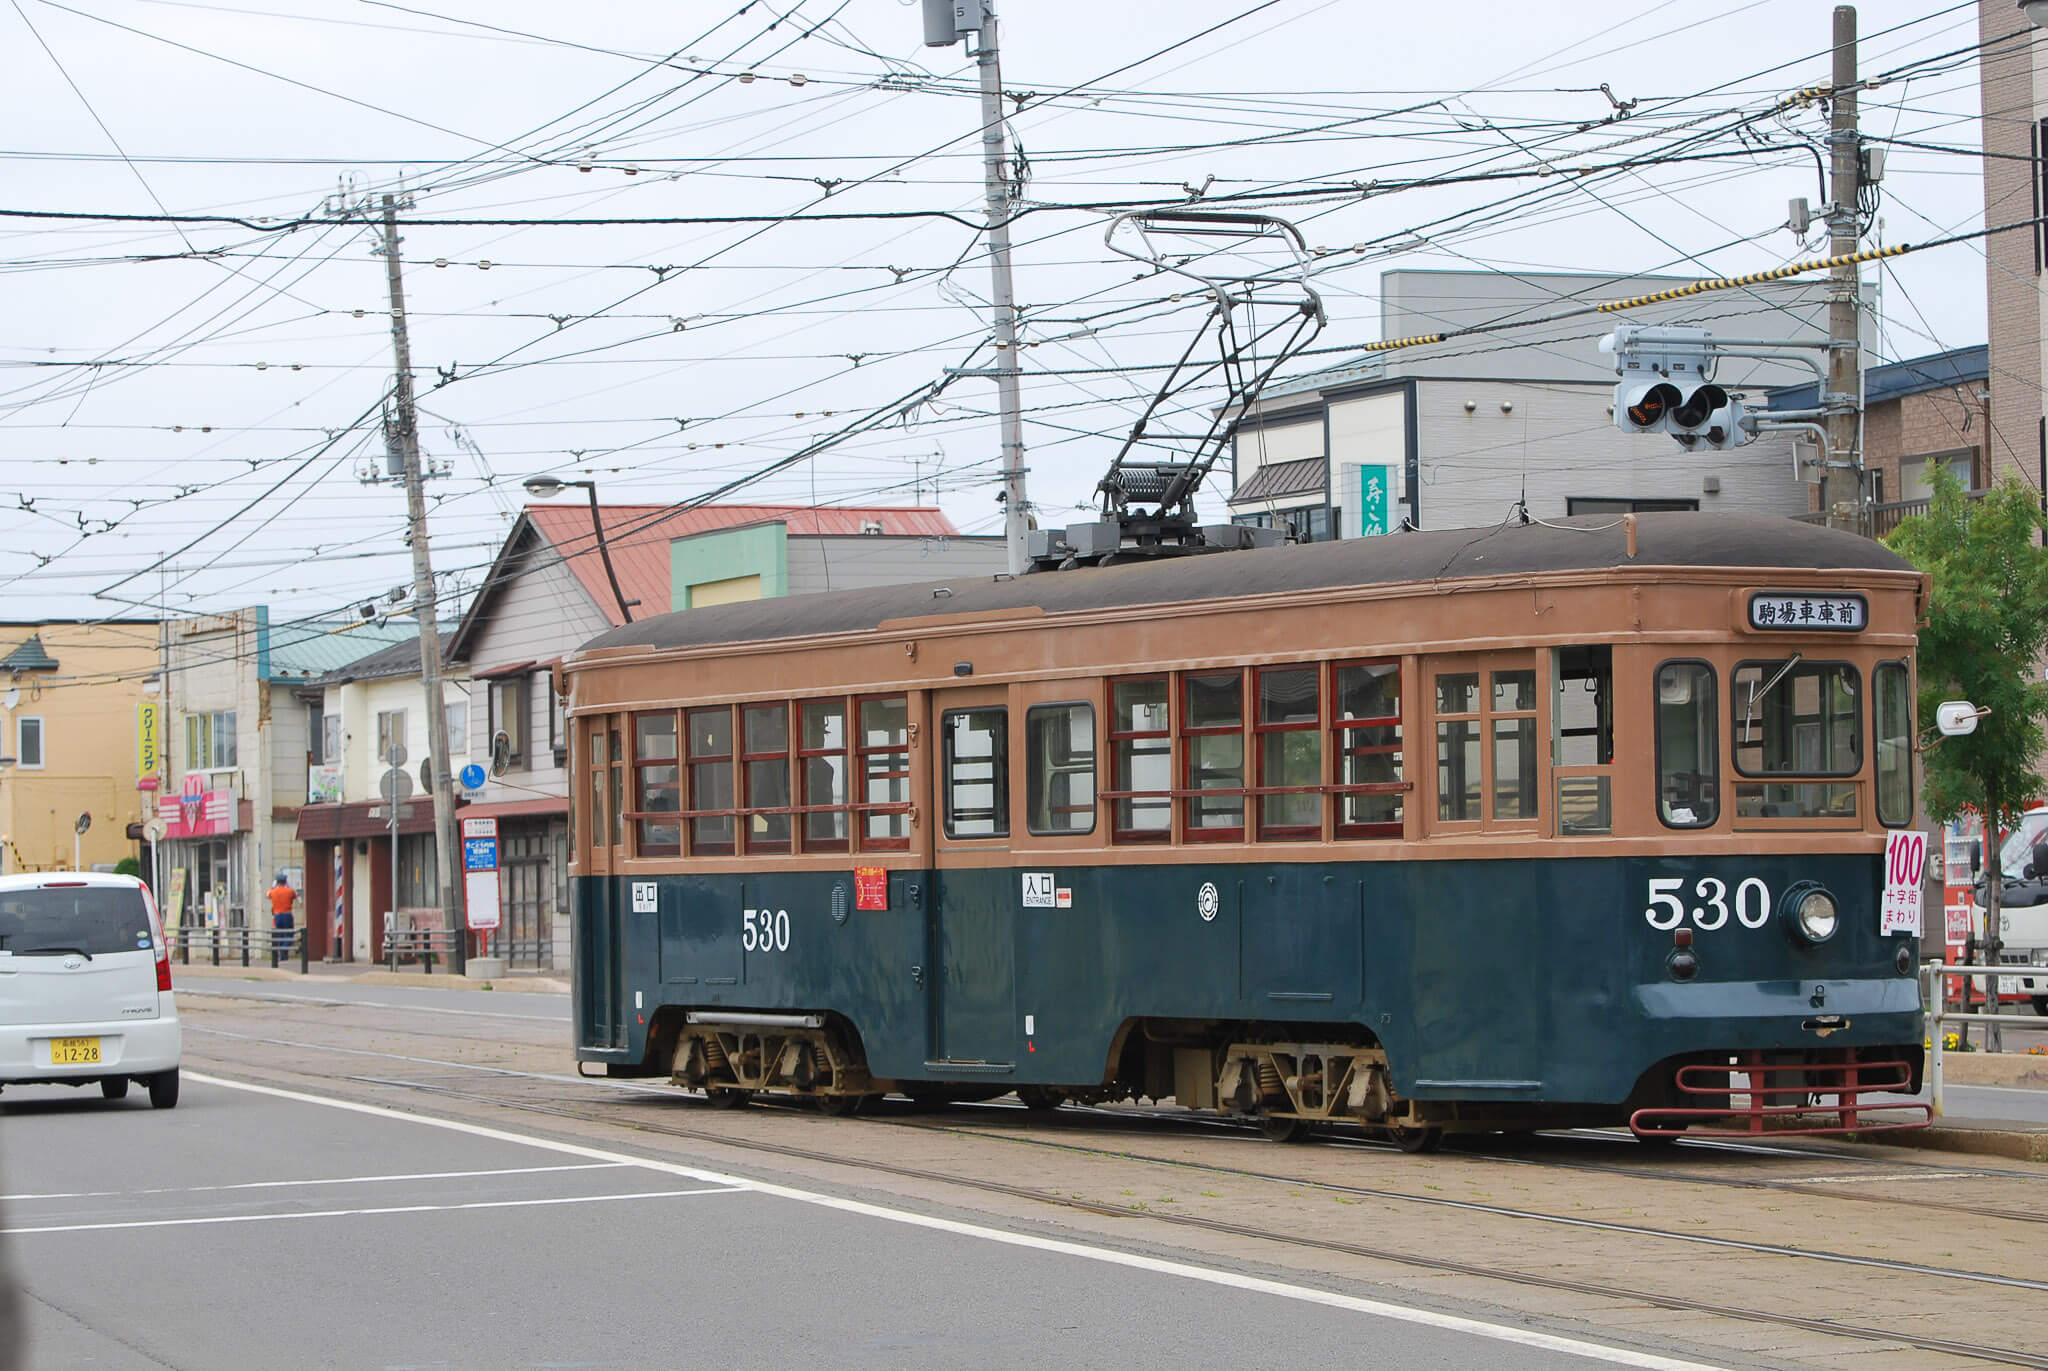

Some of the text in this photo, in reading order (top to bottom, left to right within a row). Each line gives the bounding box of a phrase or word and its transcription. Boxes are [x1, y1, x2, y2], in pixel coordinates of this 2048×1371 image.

[956, 7, 965, 17] 5
[1759, 599, 1856, 624] 駒場車庫前
[143, 708, 154, 770] クリーニング
[1889, 834, 1922, 886] 100
[636, 885, 655, 901] 出口
[1026, 875, 1051, 895] 入口
[1026, 896, 1052, 905] ENTRANCE
[1645, 877, 1771, 931] 530
[1887, 889, 1917, 904] 十字街
[1886, 910, 1916, 924] まわり
[743, 909, 790, 952] 530
[64, 1047, 98, 1061] 12-28
